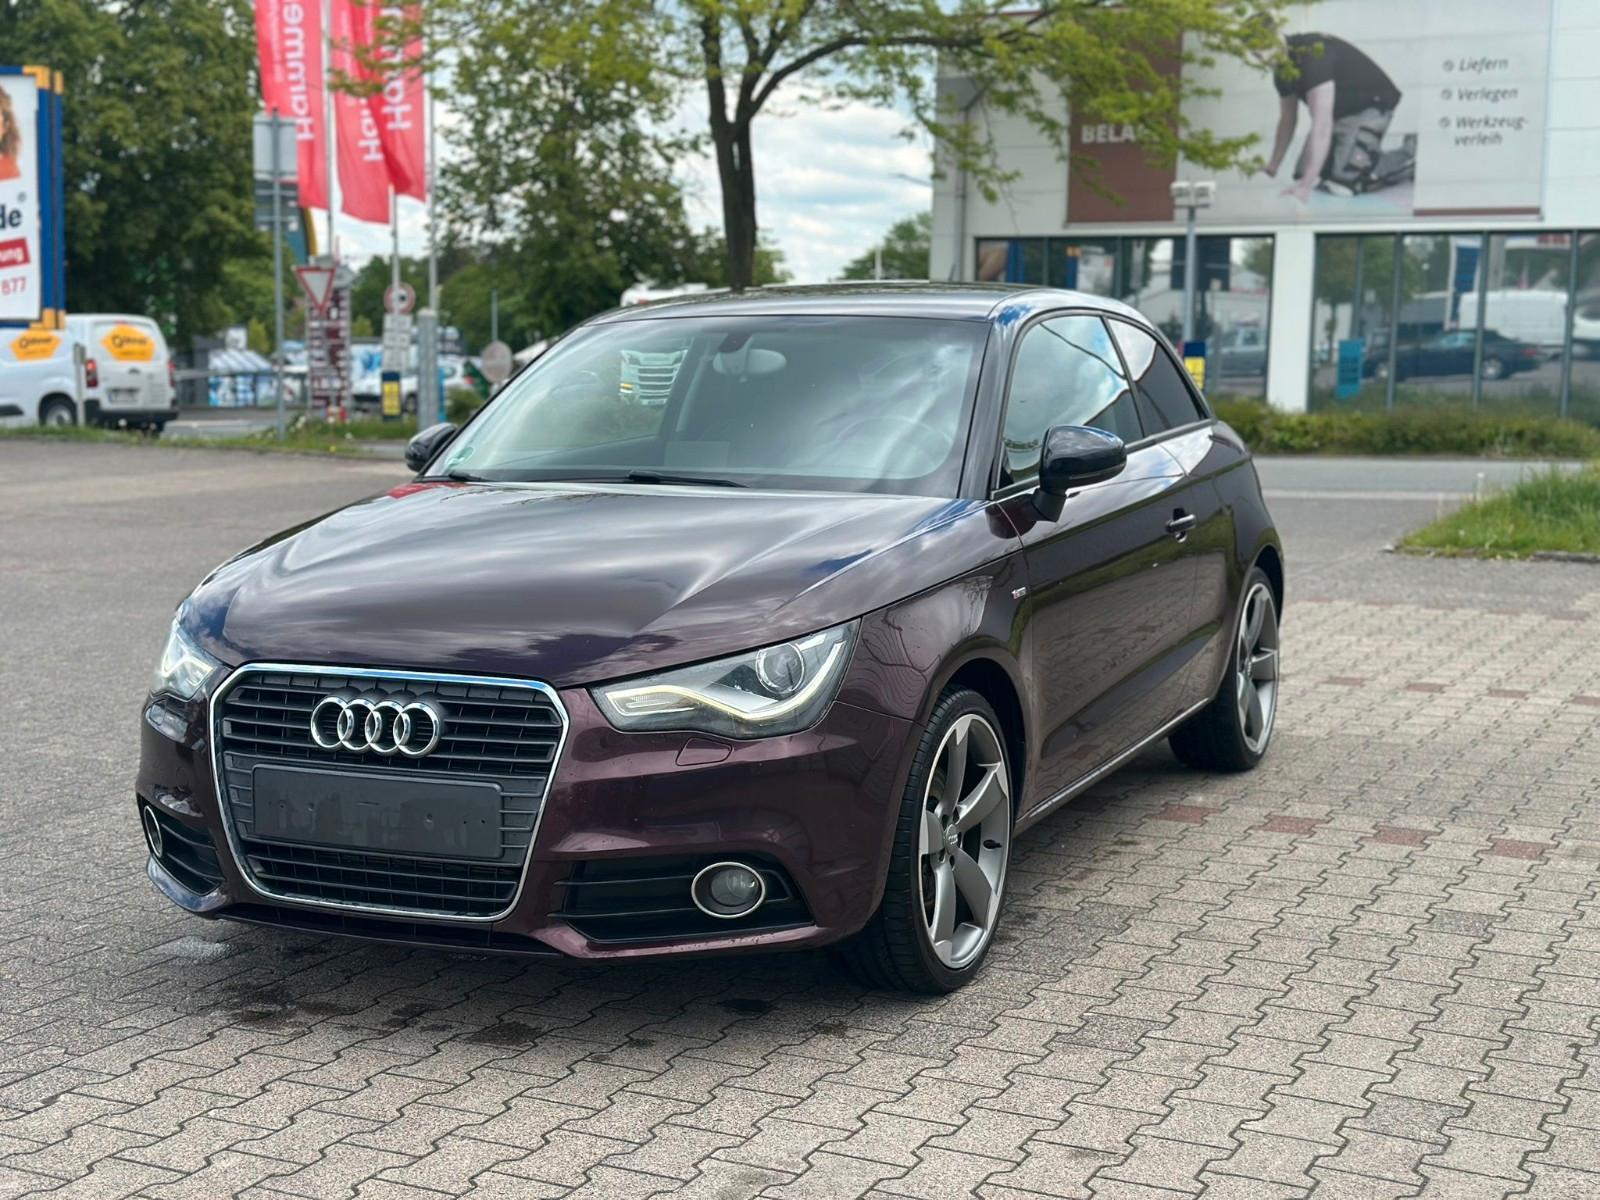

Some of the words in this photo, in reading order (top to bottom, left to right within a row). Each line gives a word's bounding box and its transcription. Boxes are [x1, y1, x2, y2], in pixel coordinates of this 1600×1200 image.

[1459, 56, 1509, 74] Liefern
[1457, 86, 1519, 103] Verlegen
[1456, 115, 1528, 131] Werkzeug-
[1081, 123, 1150, 144] BELA
[1454, 131, 1504, 146] verleih
